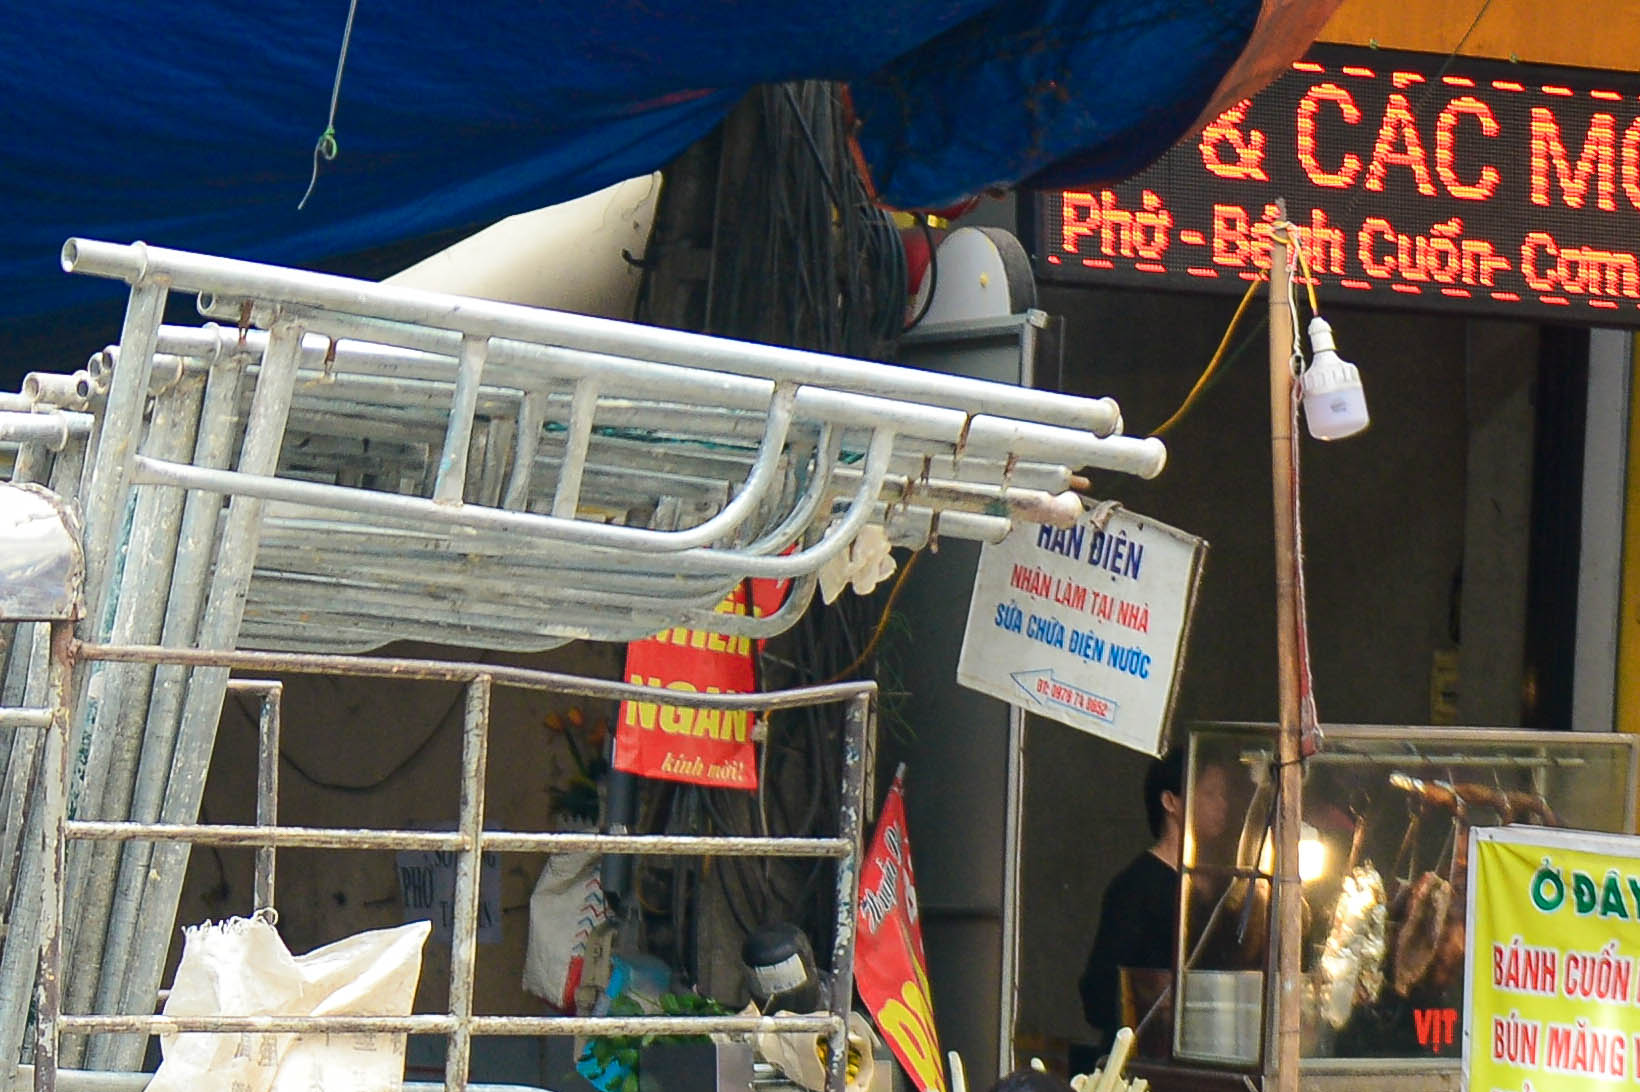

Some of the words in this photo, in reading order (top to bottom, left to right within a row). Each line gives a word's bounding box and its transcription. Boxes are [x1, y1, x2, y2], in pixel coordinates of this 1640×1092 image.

[1199, 98, 1269, 181] &
[1297, 72, 1501, 201] CÁC
[1530, 104, 1640, 213] M
[1088, 531, 1143, 581] ĐIỆN
[1011, 565, 1051, 601] NHẬN
[1054, 576, 1087, 612] LÀM
[1092, 591, 1115, 624] TẠI
[1116, 601, 1151, 634] NHÀ
[994, 599, 1024, 635] SỬA
[1026, 613, 1065, 649] CHỮA
[1068, 629, 1106, 665] ĐIỆN
[1107, 641, 1152, 680] NƯỚC
[1531, 857, 1565, 912] Ở
[1493, 937, 1557, 993] BÁNH
[1564, 942, 1631, 1001] CUỐN
[1413, 1007, 1458, 1055] VỊT
[1493, 1012, 1539, 1066] BÚN
[1547, 1020, 1626, 1078] MĂNG
